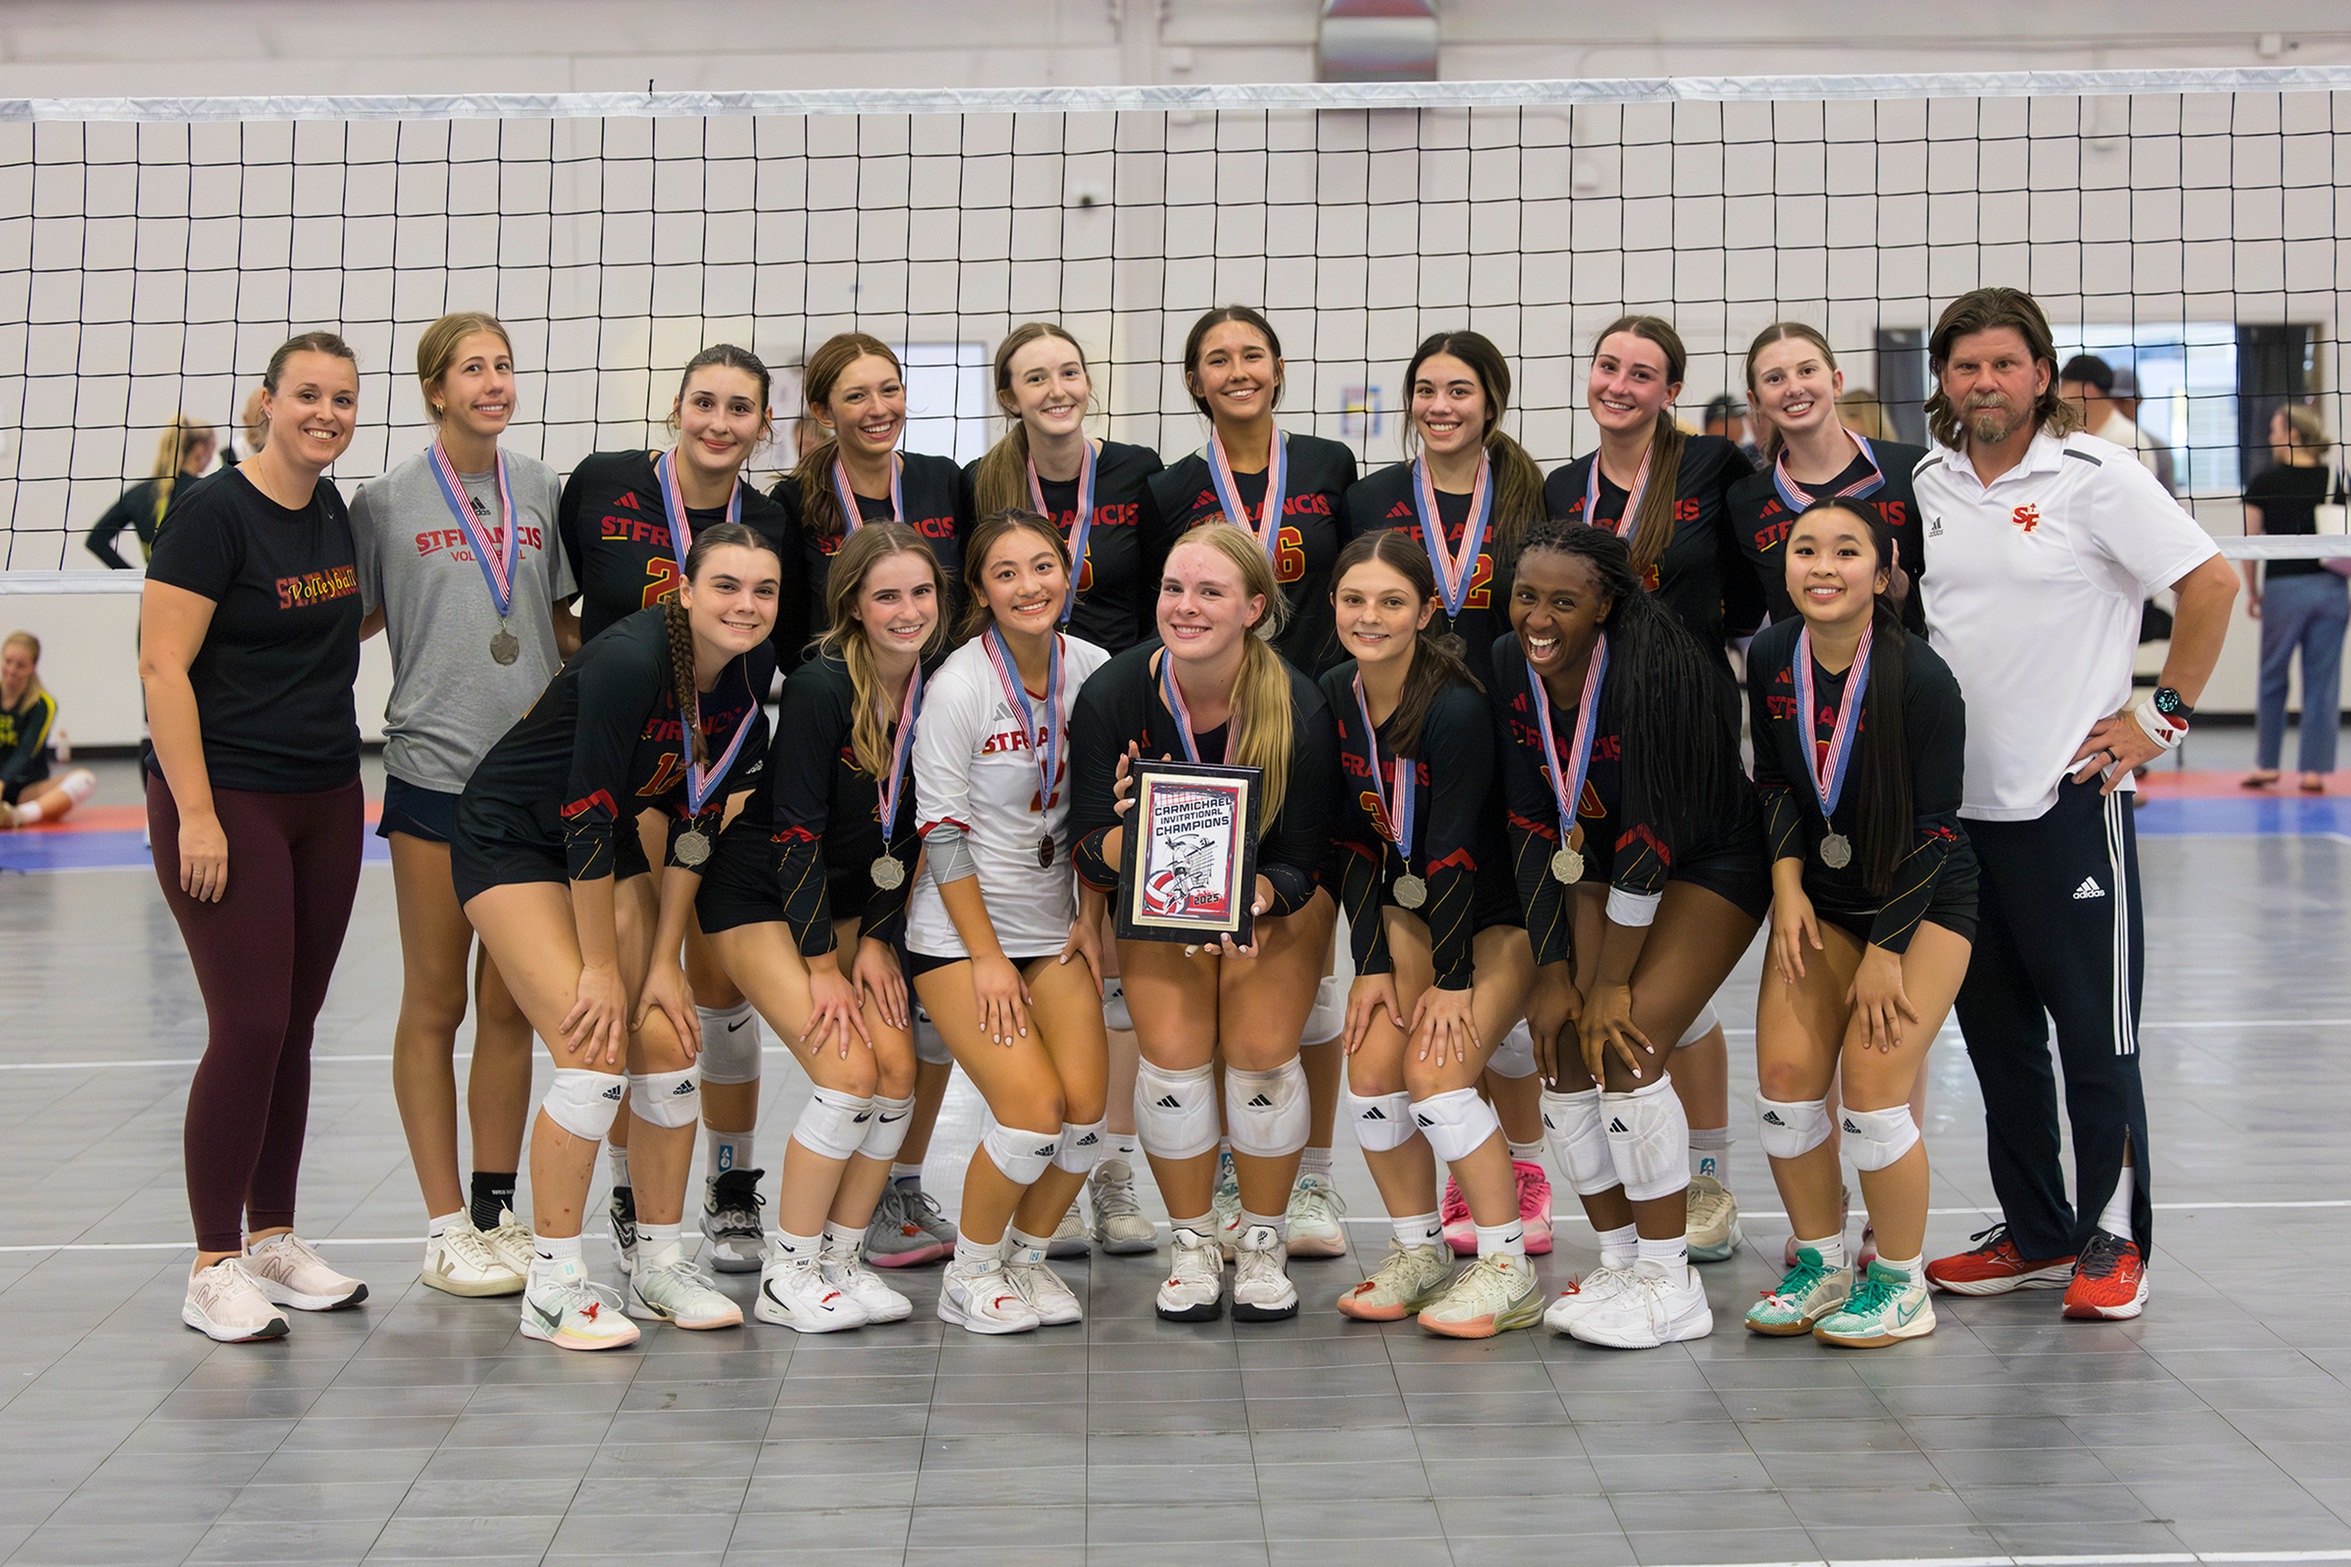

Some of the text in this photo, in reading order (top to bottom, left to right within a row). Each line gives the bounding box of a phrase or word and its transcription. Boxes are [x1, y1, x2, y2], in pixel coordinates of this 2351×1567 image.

[1155, 797, 1232, 816] CARMICHAEL
[1161, 808, 1223, 824] INVITATIONAL
[1156, 816, 1230, 836] CHAMPIONS
[1194, 893, 1220, 906] 2025
[2073, 889, 2105, 900] adidas
